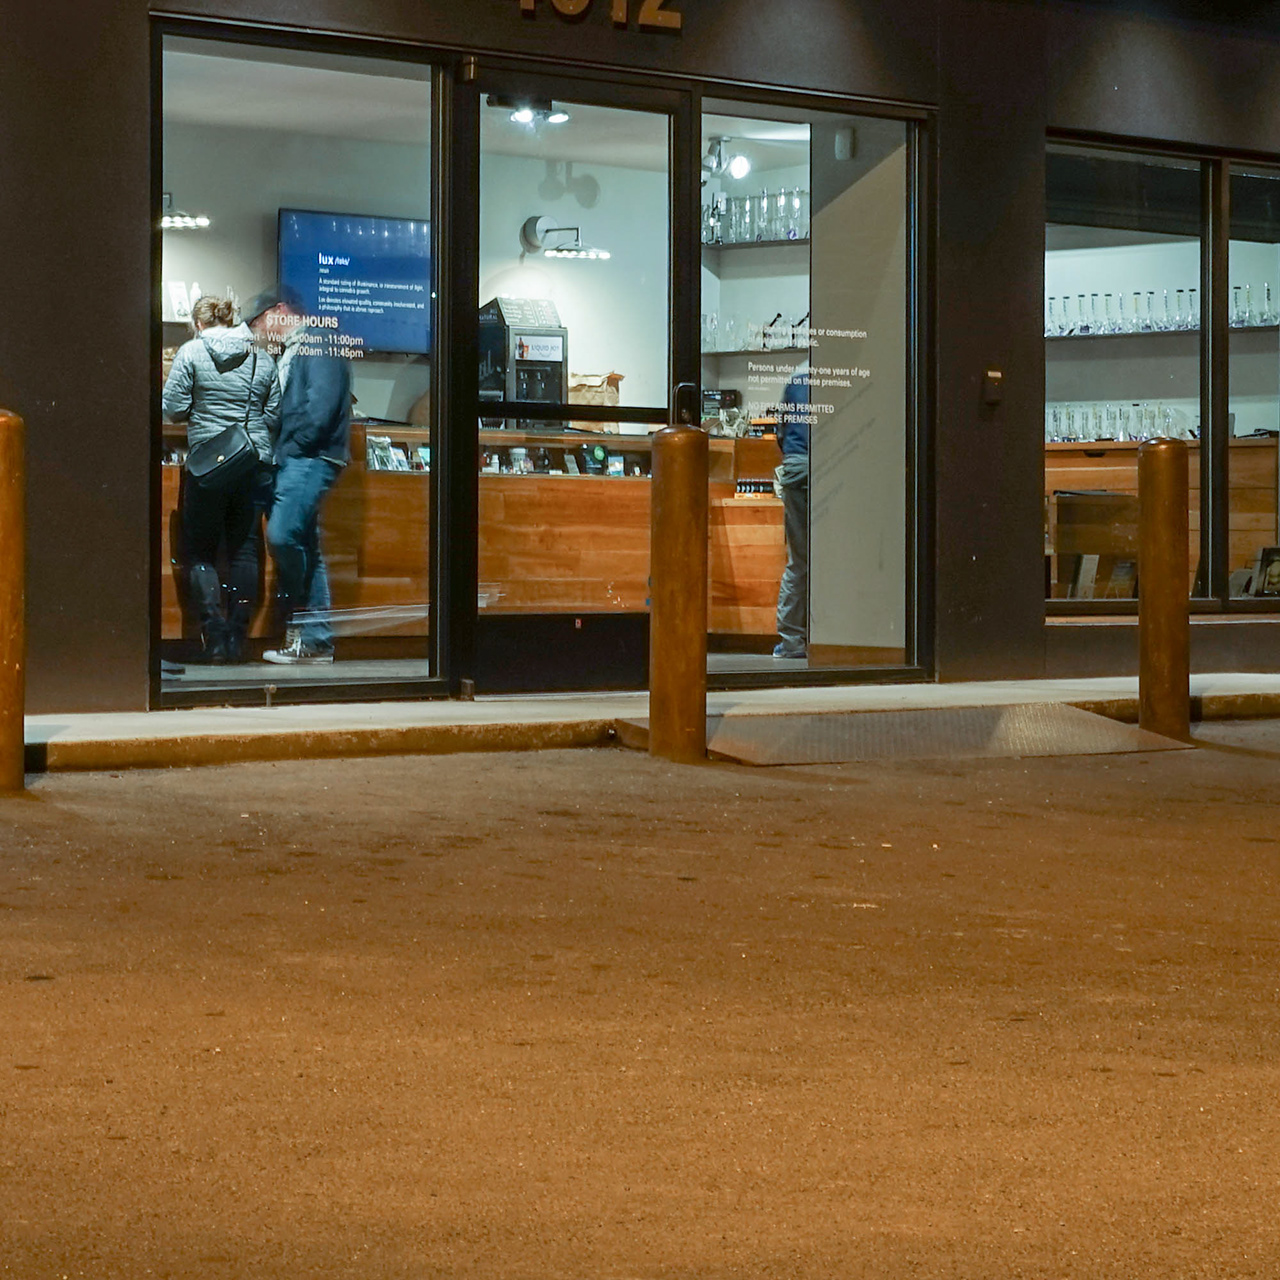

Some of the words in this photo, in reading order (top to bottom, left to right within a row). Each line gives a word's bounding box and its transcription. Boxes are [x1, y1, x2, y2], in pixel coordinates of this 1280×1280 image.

[266, 315, 299, 326] STORE
[302, 316, 338, 328] HOURS
[826, 328, 867, 339] consumption
[267, 345, 281, 355] Sat
[748, 362, 774, 372] Persons
[775, 364, 794, 373] under
[832, 368, 850, 377] years
[851, 367, 858, 377] of
[858, 369, 870, 379] age
[748, 375, 759, 383] not
[760, 375, 792, 385] permitted
[802, 377, 820, 386] these
[821, 378, 852, 388] premises.
[796, 403, 835, 414] PERMITTED
[784, 414, 818, 425] PREMISES
